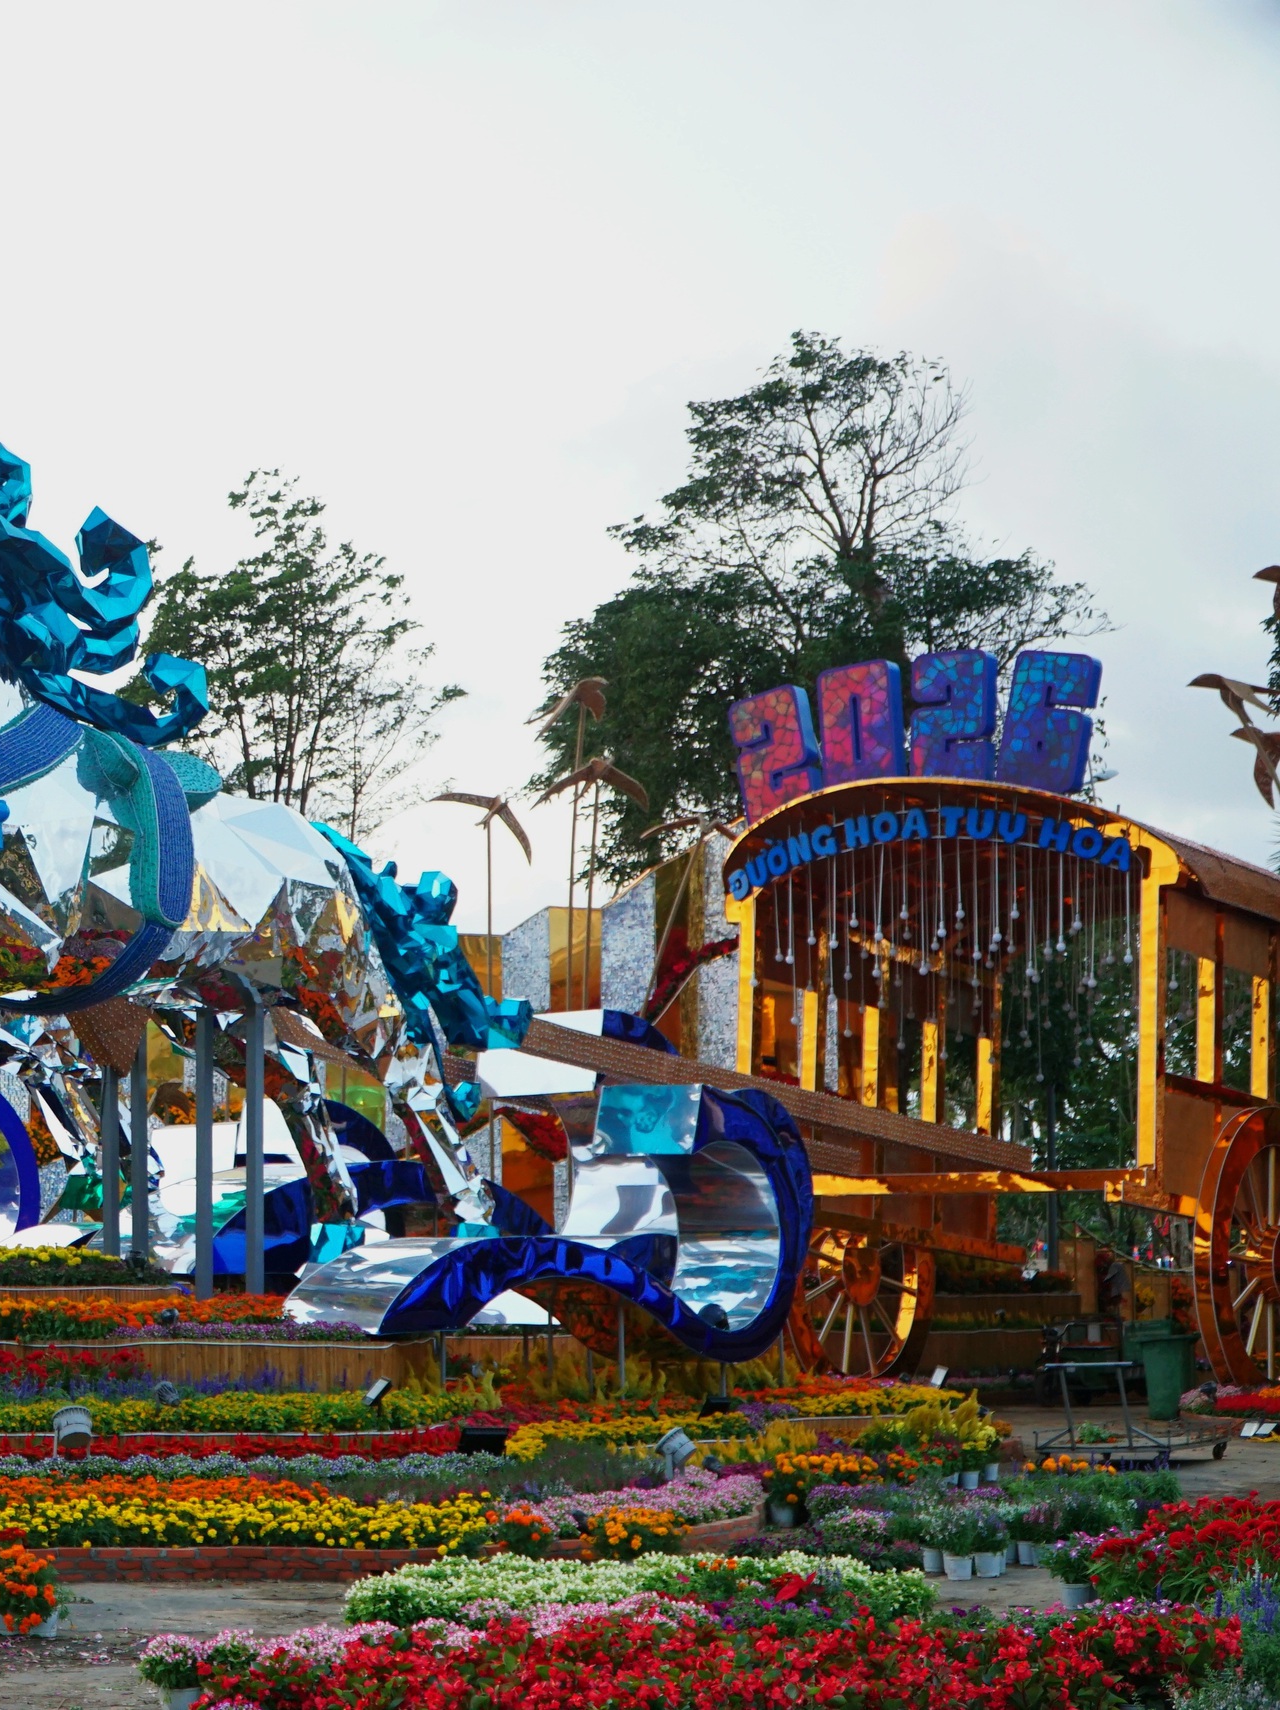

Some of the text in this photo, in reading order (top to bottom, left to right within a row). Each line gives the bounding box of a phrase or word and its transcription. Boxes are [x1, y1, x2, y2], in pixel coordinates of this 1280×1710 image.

[728, 648, 1103, 826] 2026
[728, 824, 838, 901] ĐƯỜNG
[845, 807, 930, 849] HOA
